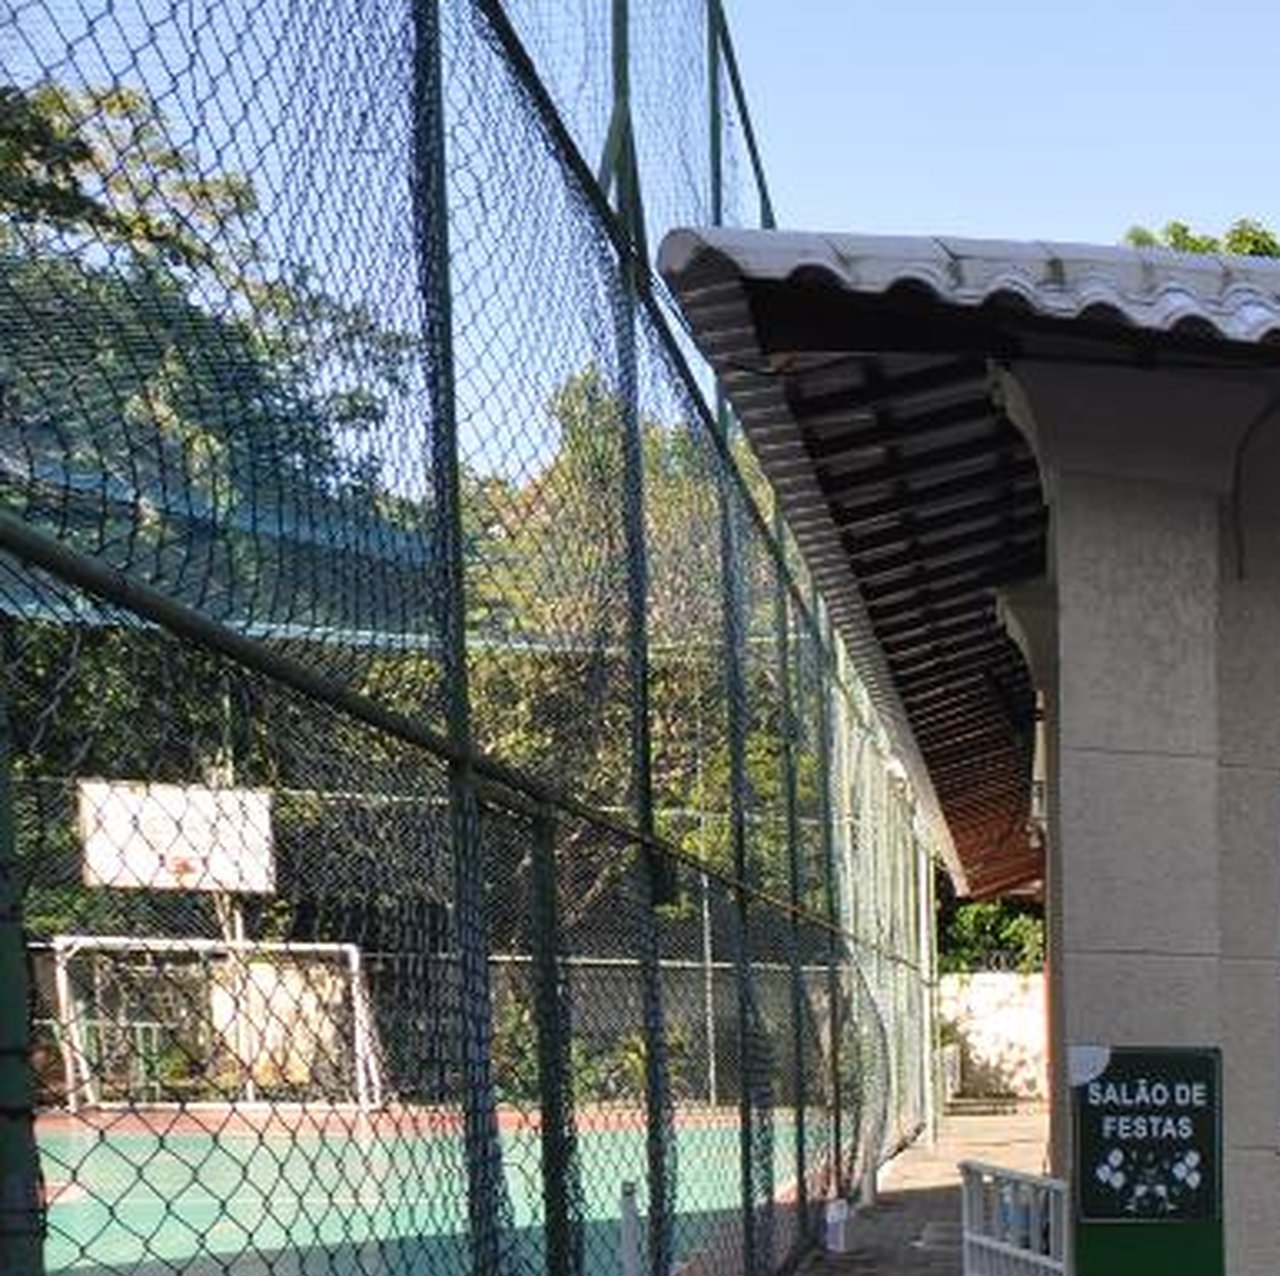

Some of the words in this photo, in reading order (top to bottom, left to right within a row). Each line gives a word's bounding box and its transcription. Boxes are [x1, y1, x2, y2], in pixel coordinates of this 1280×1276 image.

[1088, 1078, 1169, 1105] SALÃO
[1175, 1083, 1207, 1105] DE
[1102, 1115, 1194, 1139] FESTAS
